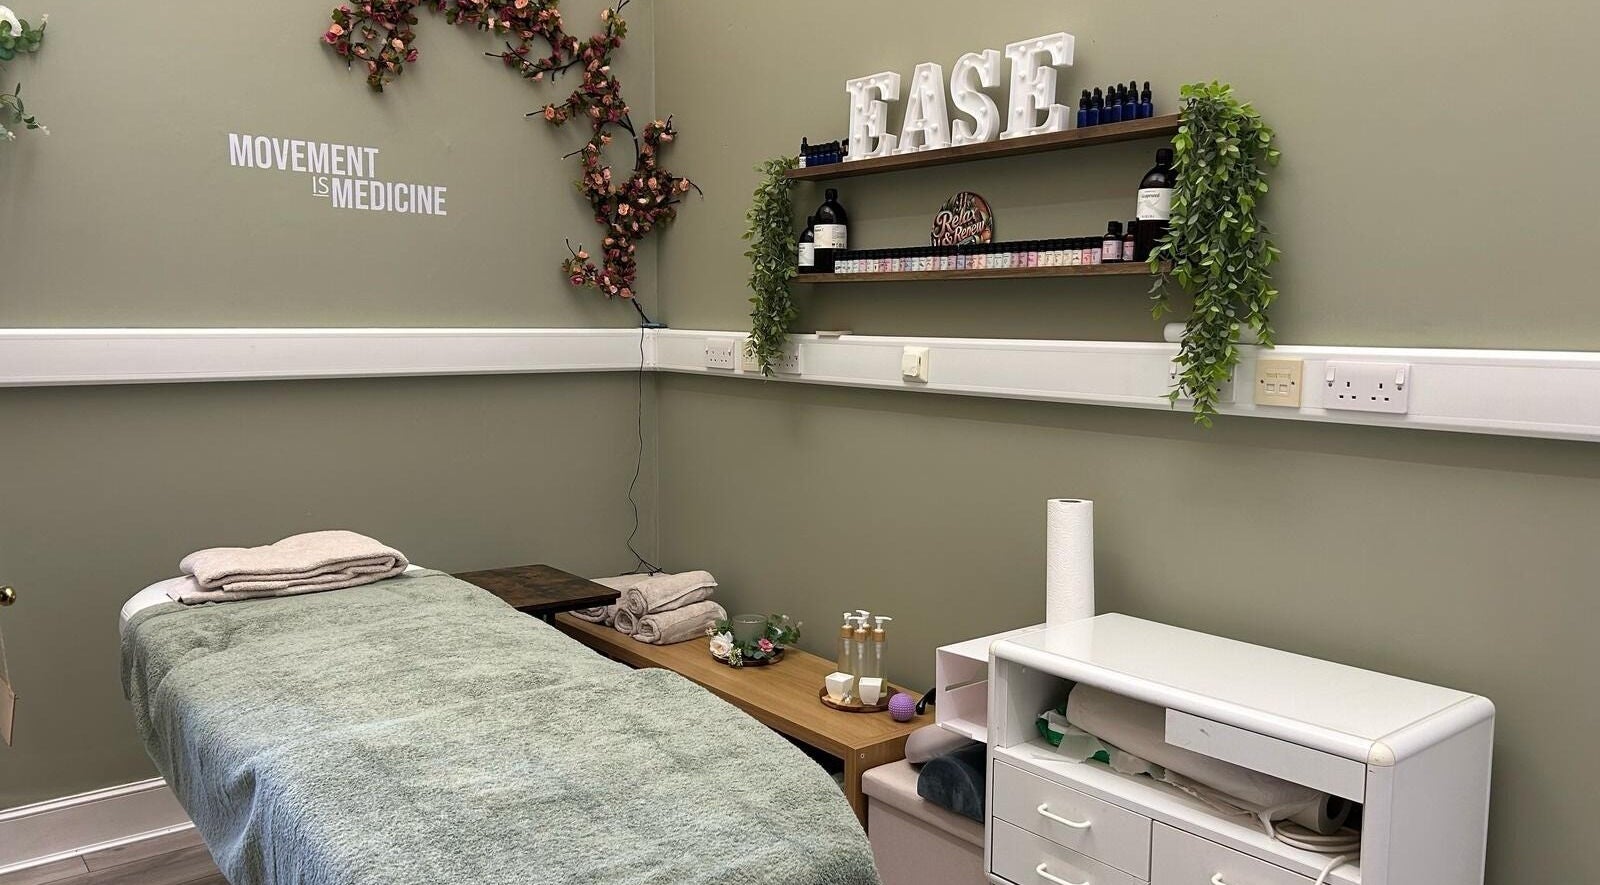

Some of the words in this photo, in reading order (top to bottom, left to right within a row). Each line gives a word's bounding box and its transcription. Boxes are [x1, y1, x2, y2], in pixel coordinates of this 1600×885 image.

[843, 32, 1075, 161] EASE
[229, 133, 379, 178] MOVEMENT
[312, 176, 329, 196] IS
[331, 178, 447, 216] MEDICINE
[933, 208, 977, 238] Relax
[941, 231, 953, 246] &
[953, 220, 985, 244] Renew
